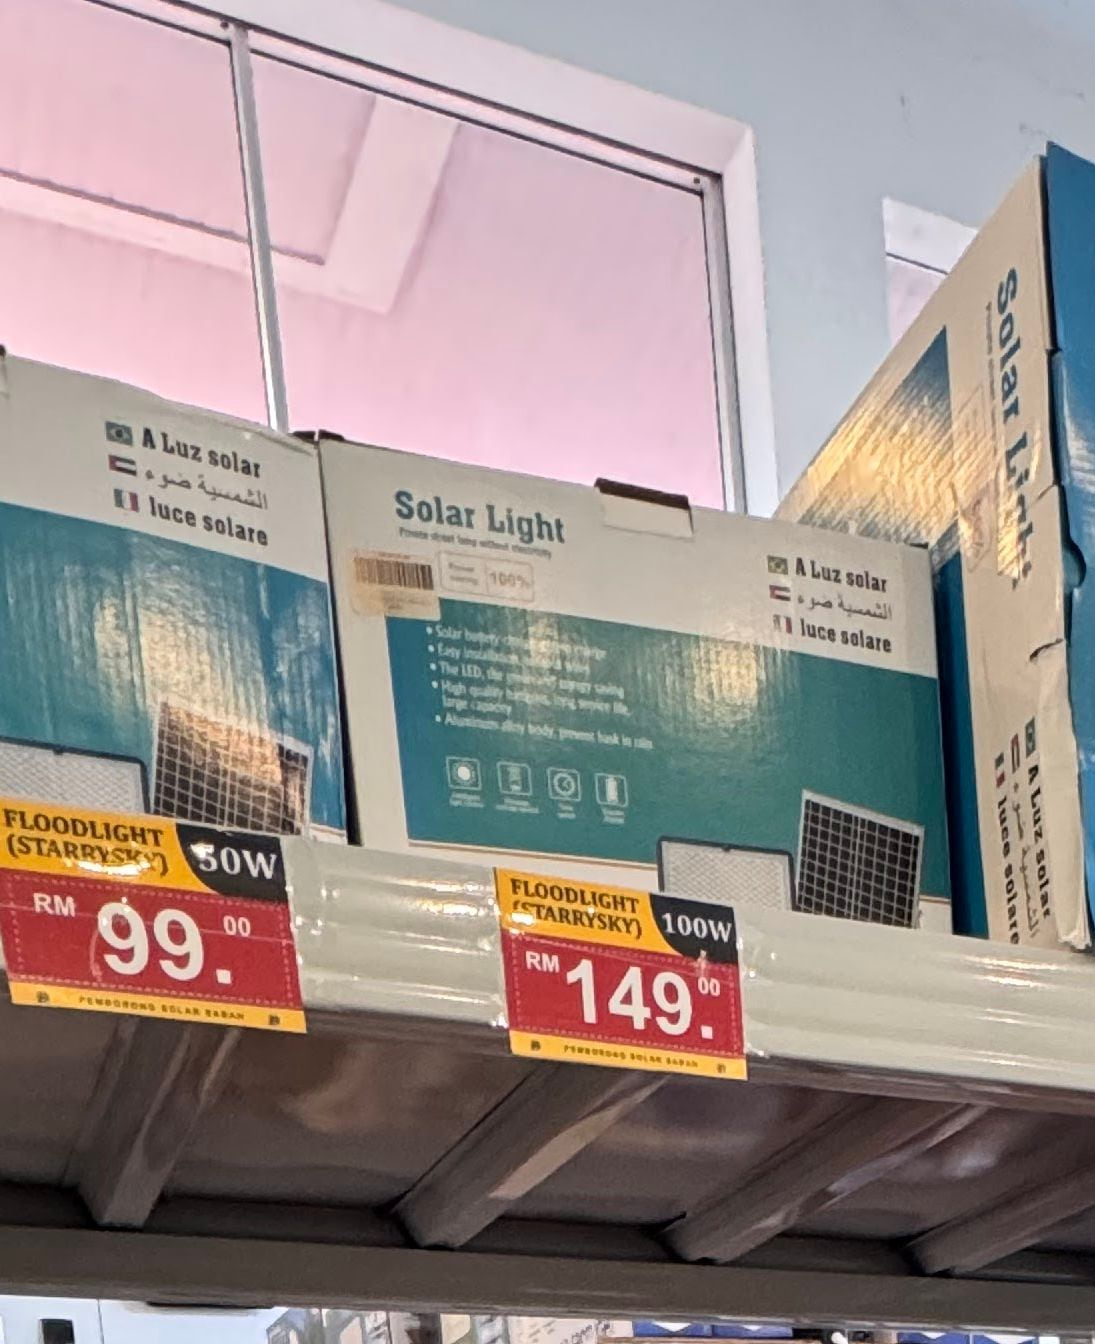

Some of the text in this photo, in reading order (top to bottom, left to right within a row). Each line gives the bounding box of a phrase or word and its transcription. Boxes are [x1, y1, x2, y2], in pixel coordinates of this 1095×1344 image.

[998, 267, 1022, 425] Solar
[142, 427, 262, 478] A Luz solar
[148, 497, 269, 547] luce solare
[394, 490, 566, 545] Solar Light
[795, 557, 888, 593] A Luz solar
[799, 617, 892, 654] luce solare
[4, 808, 278, 881] FLOODLIGHT 50W
[33, 892, 77, 918] RM
[223, 915, 252, 937] 00
[510, 878, 733, 944] FLOODLIGHT 100W
[525, 950, 560, 973] RM
[697, 977, 721, 997] 00
